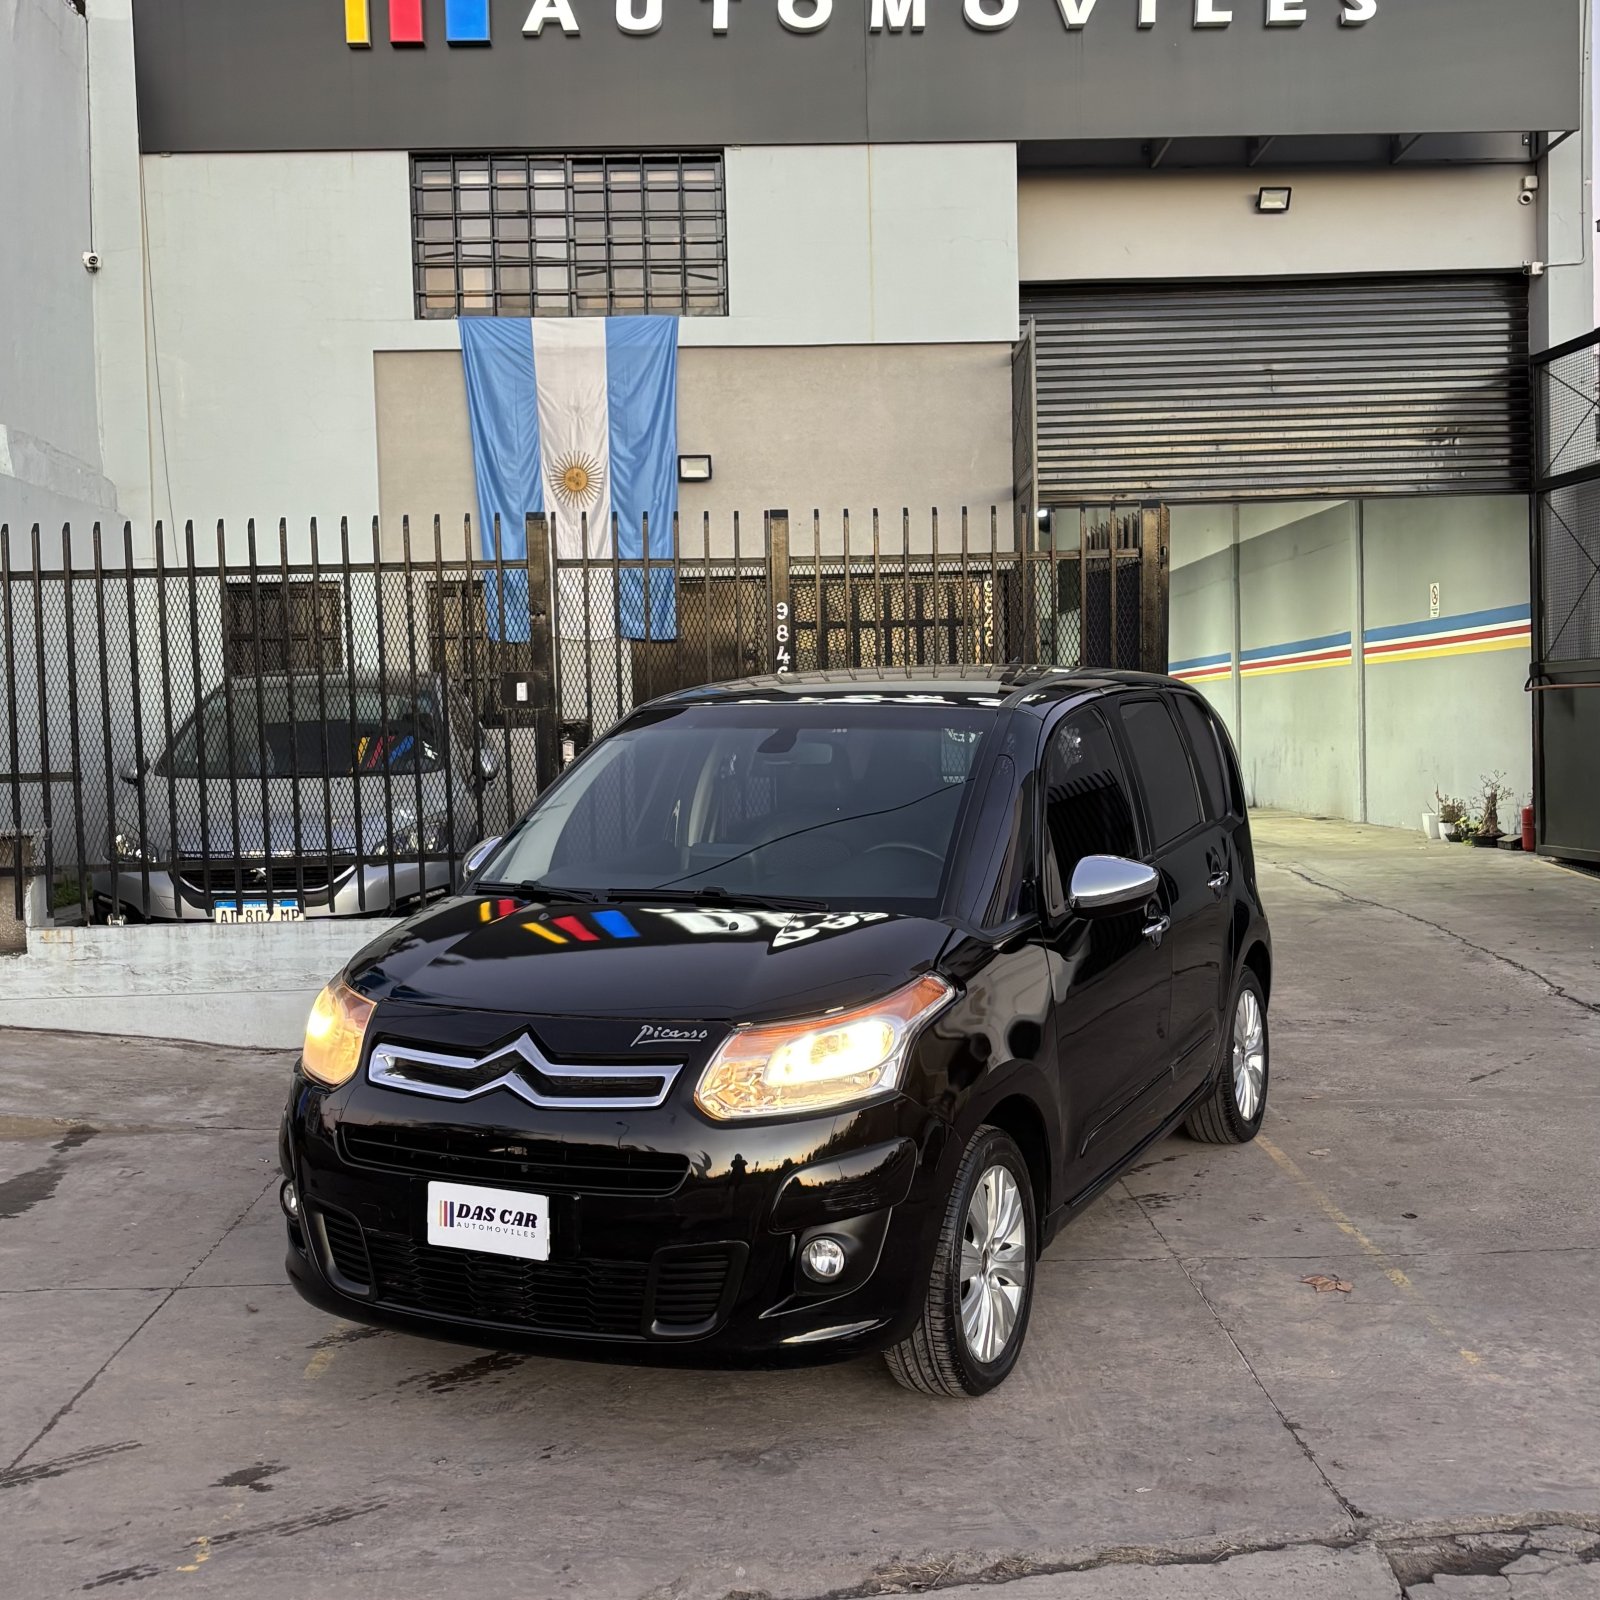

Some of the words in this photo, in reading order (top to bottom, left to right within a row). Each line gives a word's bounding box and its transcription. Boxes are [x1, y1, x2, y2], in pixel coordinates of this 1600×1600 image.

[521, 0, 1378, 36] AUTOMOVILES
[630, 1024, 708, 1048] Picasso
[456, 1203, 497, 1222] DAS
[499, 1209, 538, 1229] CAR
[456, 1221, 536, 1239] AUTOMOVILES
